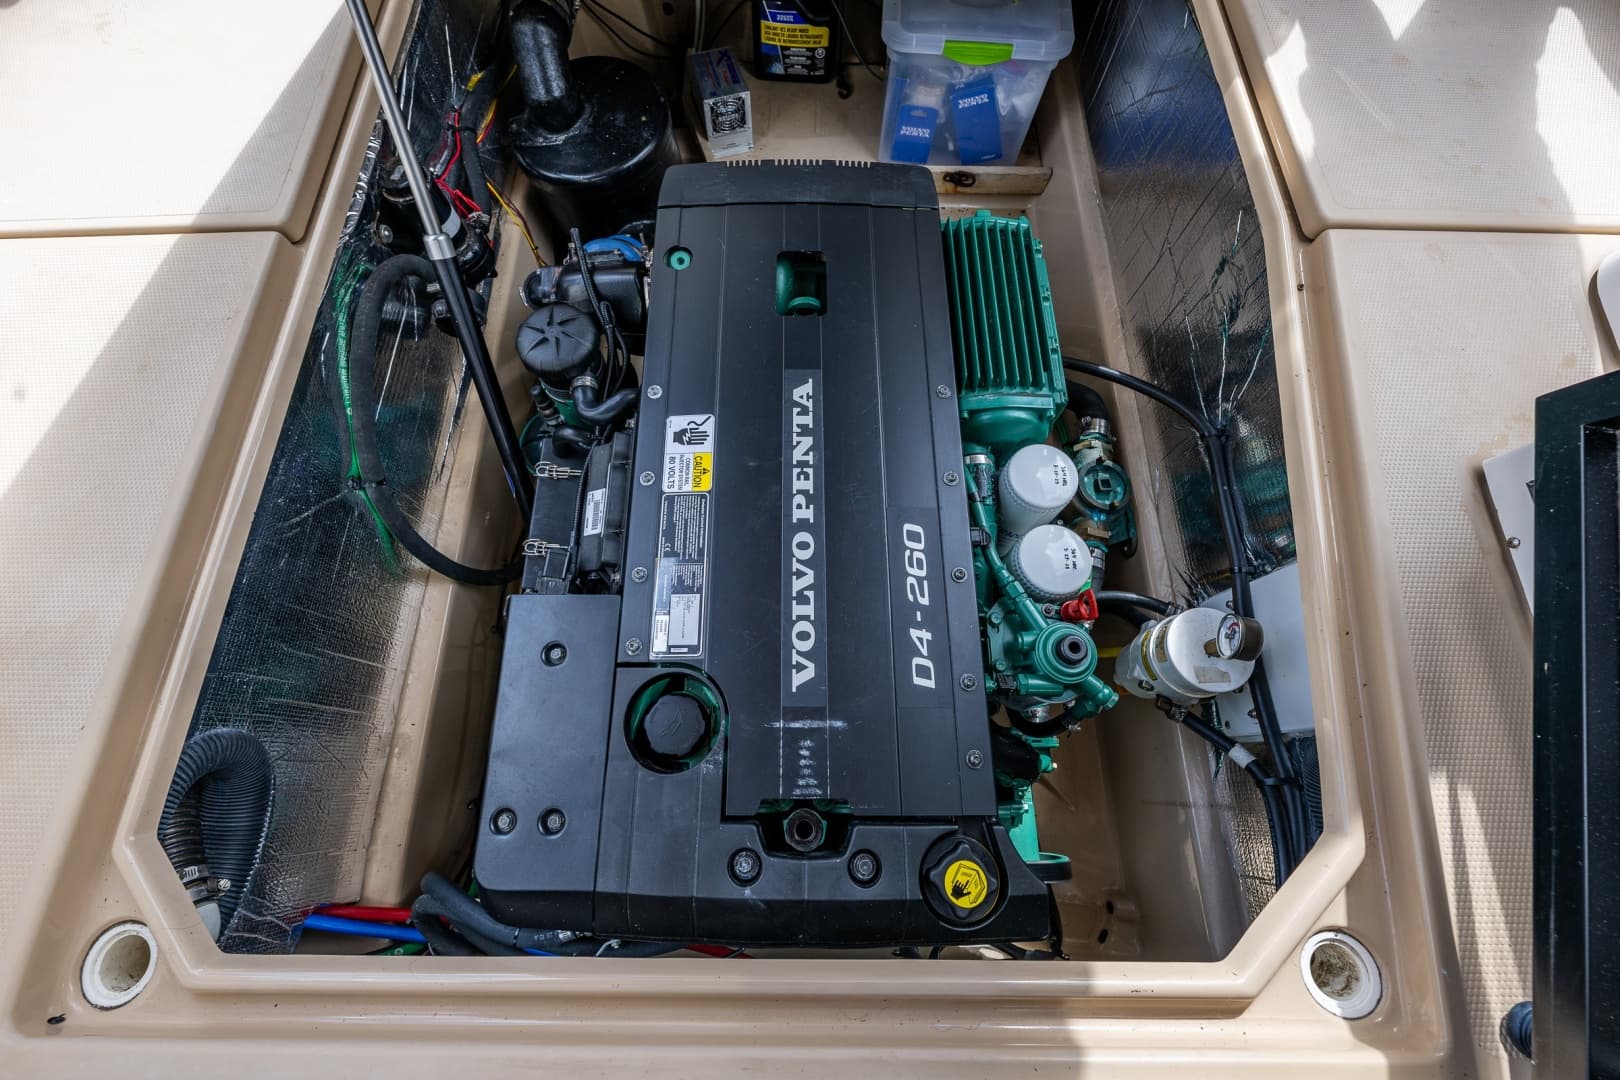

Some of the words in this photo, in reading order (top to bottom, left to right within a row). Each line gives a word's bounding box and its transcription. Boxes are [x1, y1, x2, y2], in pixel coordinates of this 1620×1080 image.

[958, 93, 988, 104] VOLVO
[958, 98, 989, 109] PENTA
[900, 130, 930, 138] PENTA
[901, 125, 930, 133] VOLVO
[792, 378, 814, 524] PENTA
[668, 456, 677, 465] 80
[667, 465, 676, 490] VOLTS
[693, 455, 703, 488] CAUTION
[791, 531, 816, 693] VOLVO
[903, 523, 936, 689] D4-260
